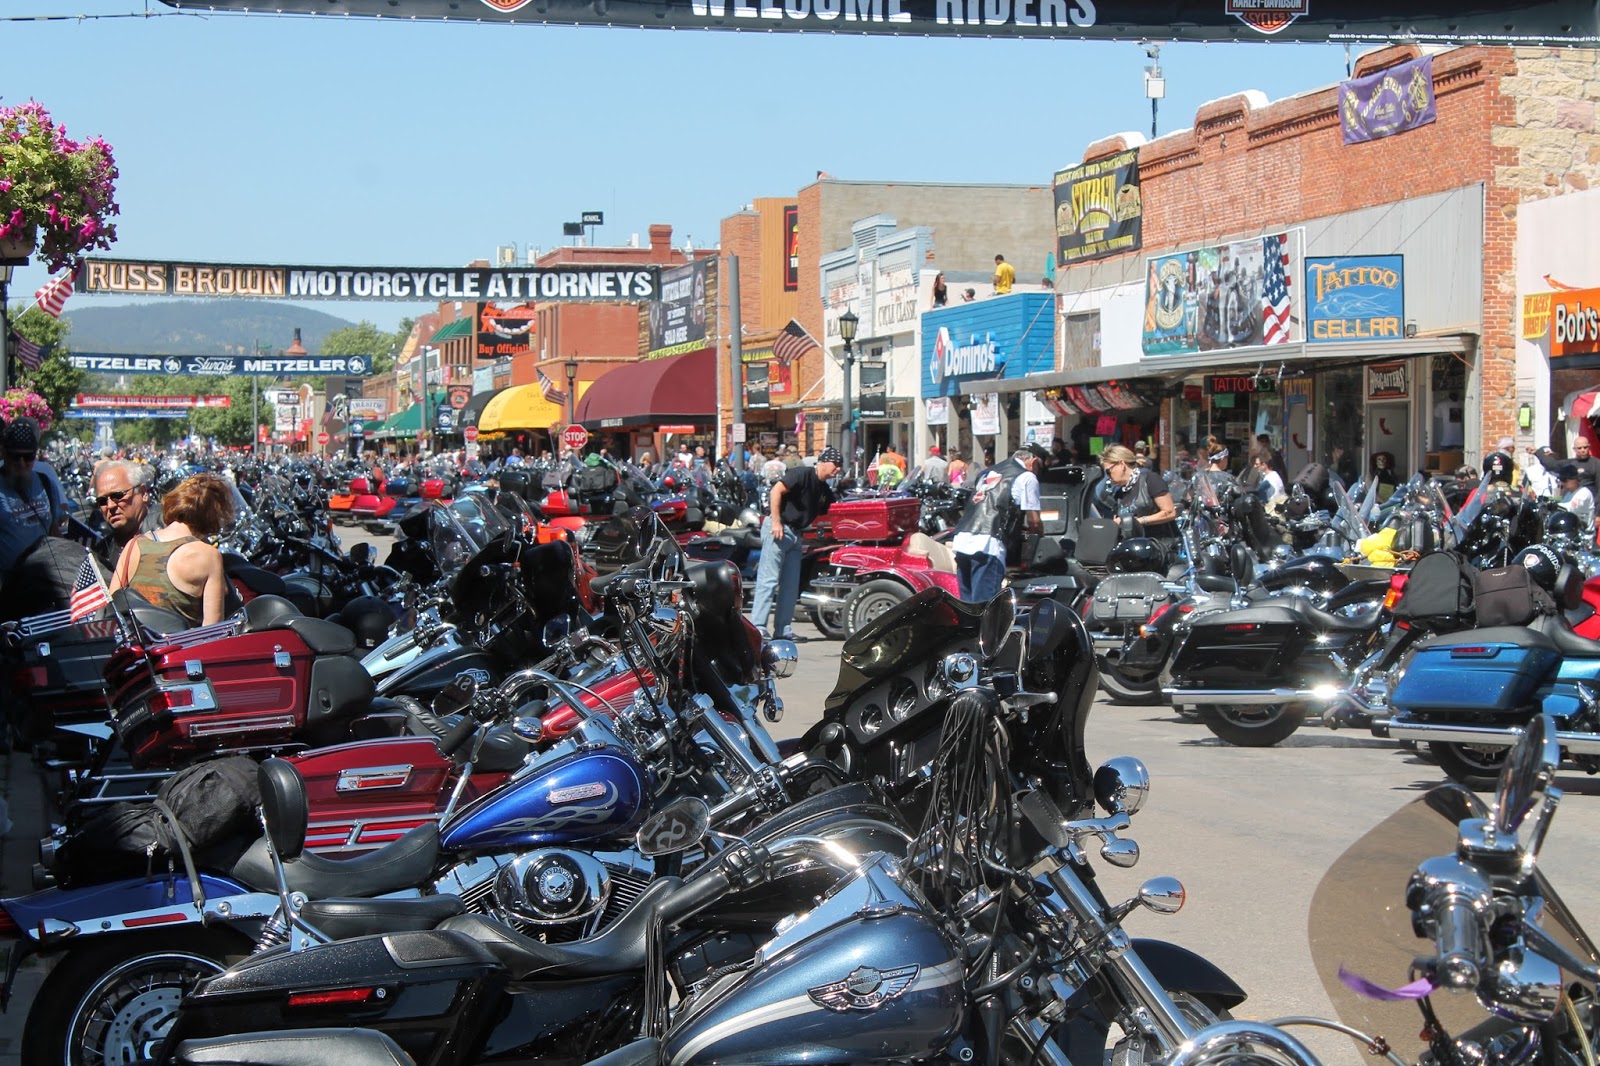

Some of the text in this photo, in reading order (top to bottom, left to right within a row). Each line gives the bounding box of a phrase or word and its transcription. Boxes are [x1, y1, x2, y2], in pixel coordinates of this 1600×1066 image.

[86, 261, 167, 292] RUSS
[173, 265, 286, 297] BROWN
[290, 270, 479, 297] MOTORCYCLE
[486, 271, 653, 298] ATTORNEYS
[1307, 262, 1400, 303] TATTOO
[1313, 317, 1399, 338] CELLAR
[1556, 301, 1598, 344] Bob's
[479, 344, 494, 356] Buy
[944, 332, 995, 377] Domino's
[186, 355, 236, 374] Sturgis
[243, 358, 346, 372] METZELER
[1213, 376, 1256, 392] TATTOO
[565, 431, 586, 442] STOP
